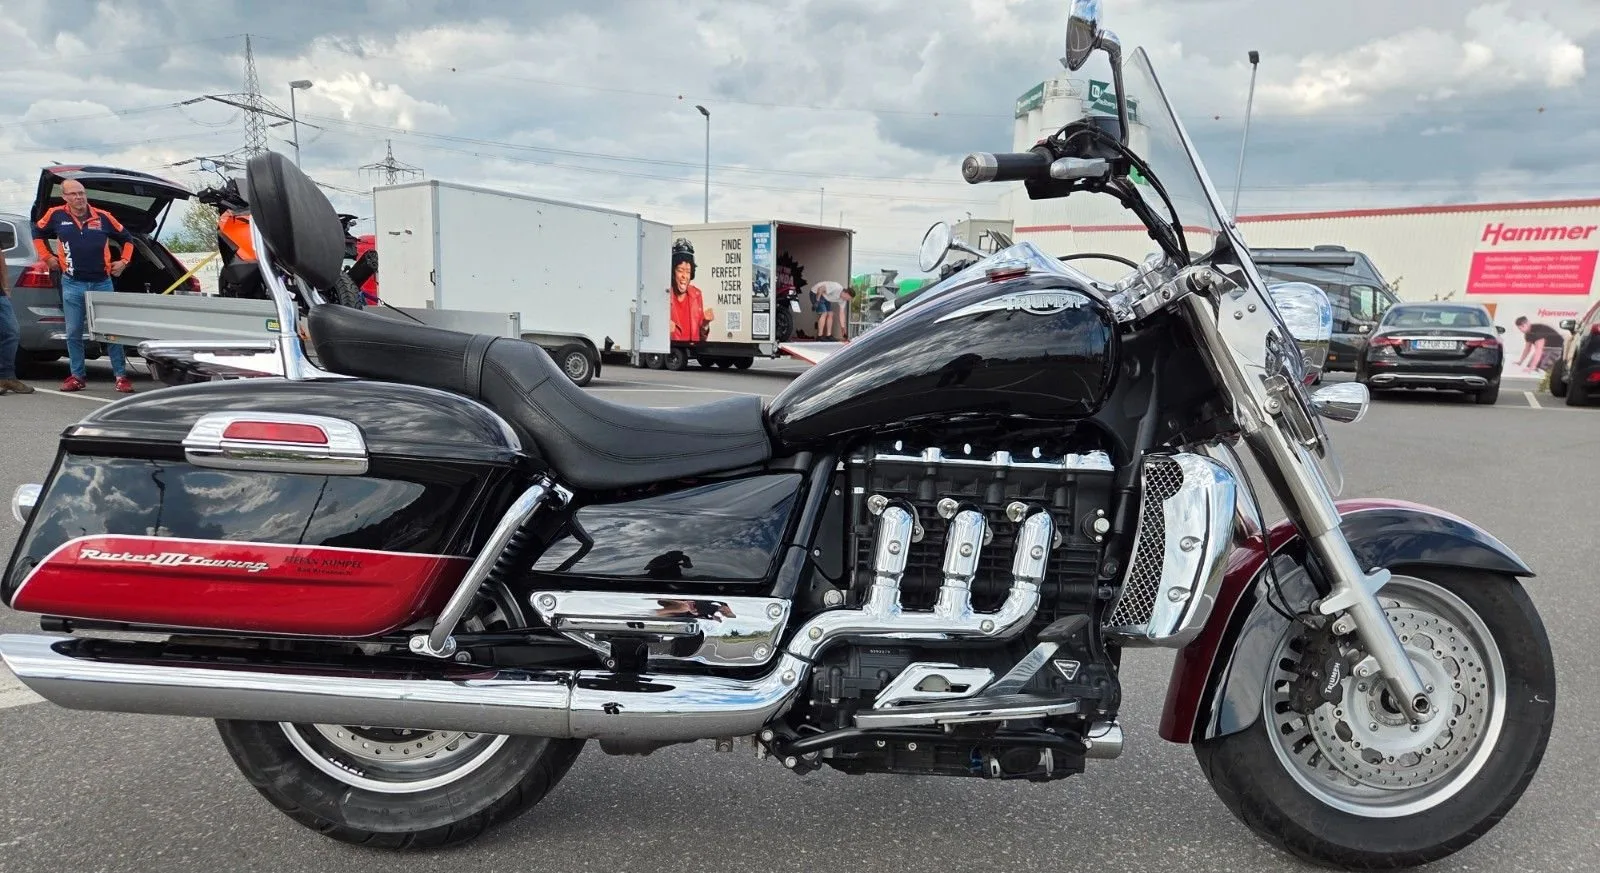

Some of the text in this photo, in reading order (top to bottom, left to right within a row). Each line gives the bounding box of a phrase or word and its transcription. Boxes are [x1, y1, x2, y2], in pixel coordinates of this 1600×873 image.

[1481, 223, 1598, 246] Hammer
[721, 239, 742, 250] FINDE
[725, 253, 742, 264] DEIN
[711, 267, 742, 278] PERFECT
[720, 280, 742, 291] 125ER
[717, 293, 742, 305] MATCH
[1002, 294, 1082, 312] TRIUMPH
[1537, 307, 1579, 319] Hammer
[78, 549, 157, 563] Rocket
[182, 555, 269, 573] Touring
[1324, 662, 1341, 694] TRIUMPH
